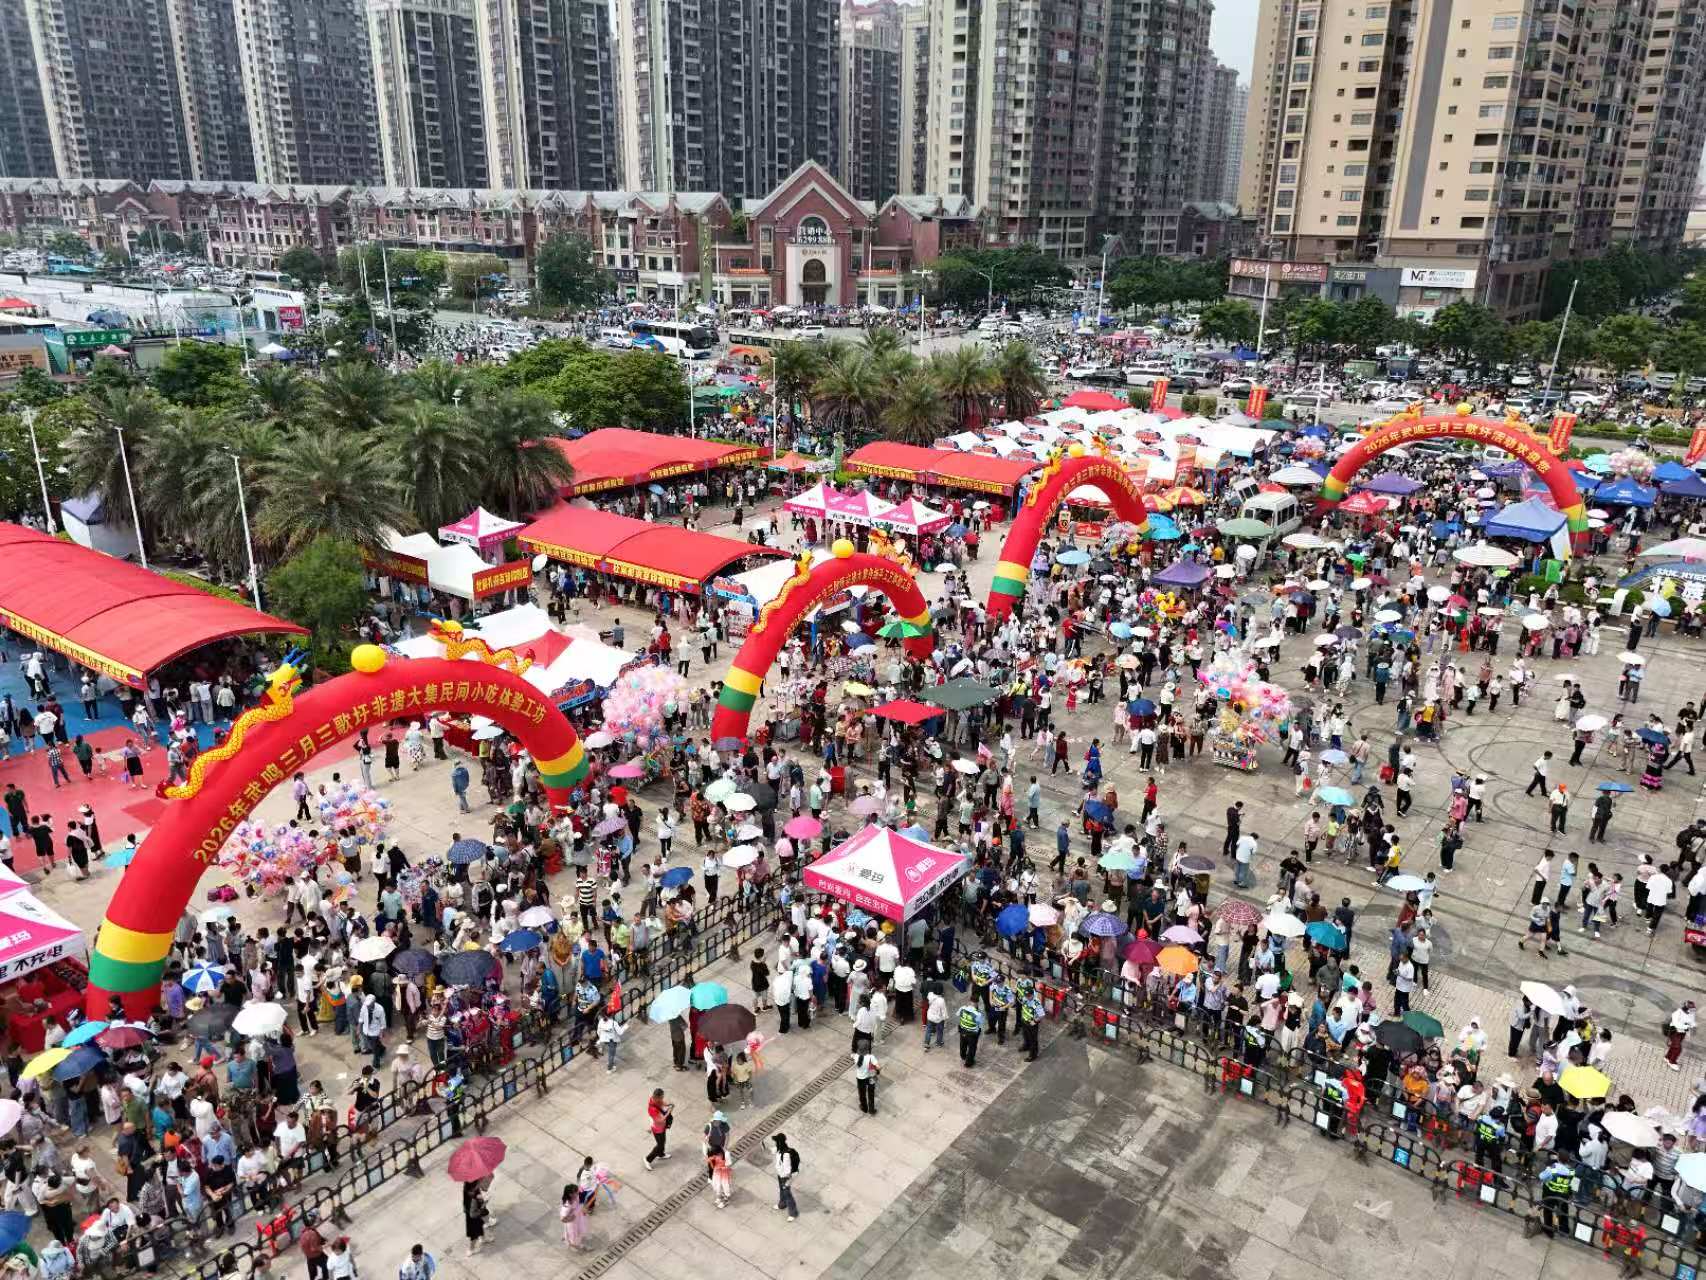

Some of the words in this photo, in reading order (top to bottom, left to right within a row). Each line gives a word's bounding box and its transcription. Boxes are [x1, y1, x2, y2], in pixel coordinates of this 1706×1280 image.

[192, 680, 548, 864] 2026年武鸣三月三歌圩非遗大集民间小吃体验工坊
